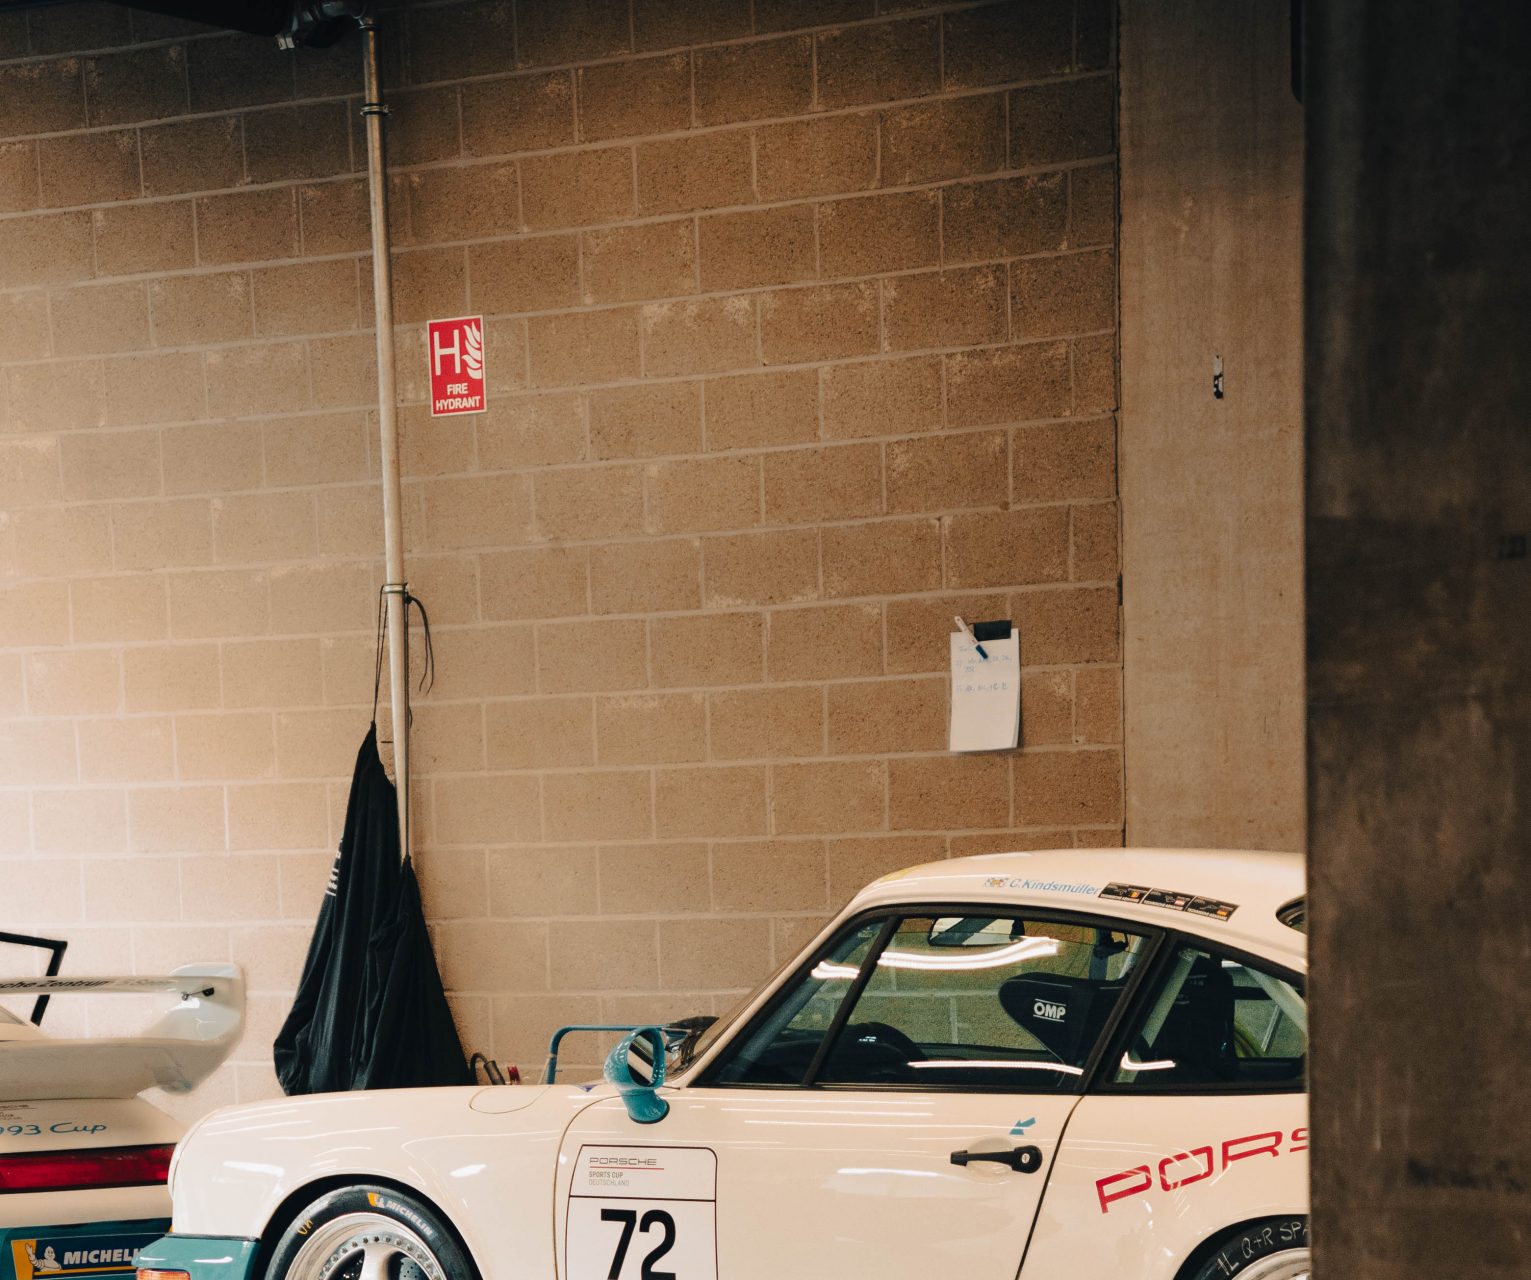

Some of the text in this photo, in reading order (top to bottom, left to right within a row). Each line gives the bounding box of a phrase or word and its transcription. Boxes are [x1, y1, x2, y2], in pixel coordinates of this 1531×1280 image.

[447, 382, 468, 395] FIRE
[435, 396, 481, 411] HYDRANT
[1033, 1001, 1066, 1019] OMP
[49, 1122, 107, 1134] Cup
[589, 1157, 657, 1166] PORSCHE
[588, 1170, 624, 1179] SPORTS CUP
[385, 1199, 434, 1237] MICHELIN
[63, 1247, 143, 1265] MICHELI
